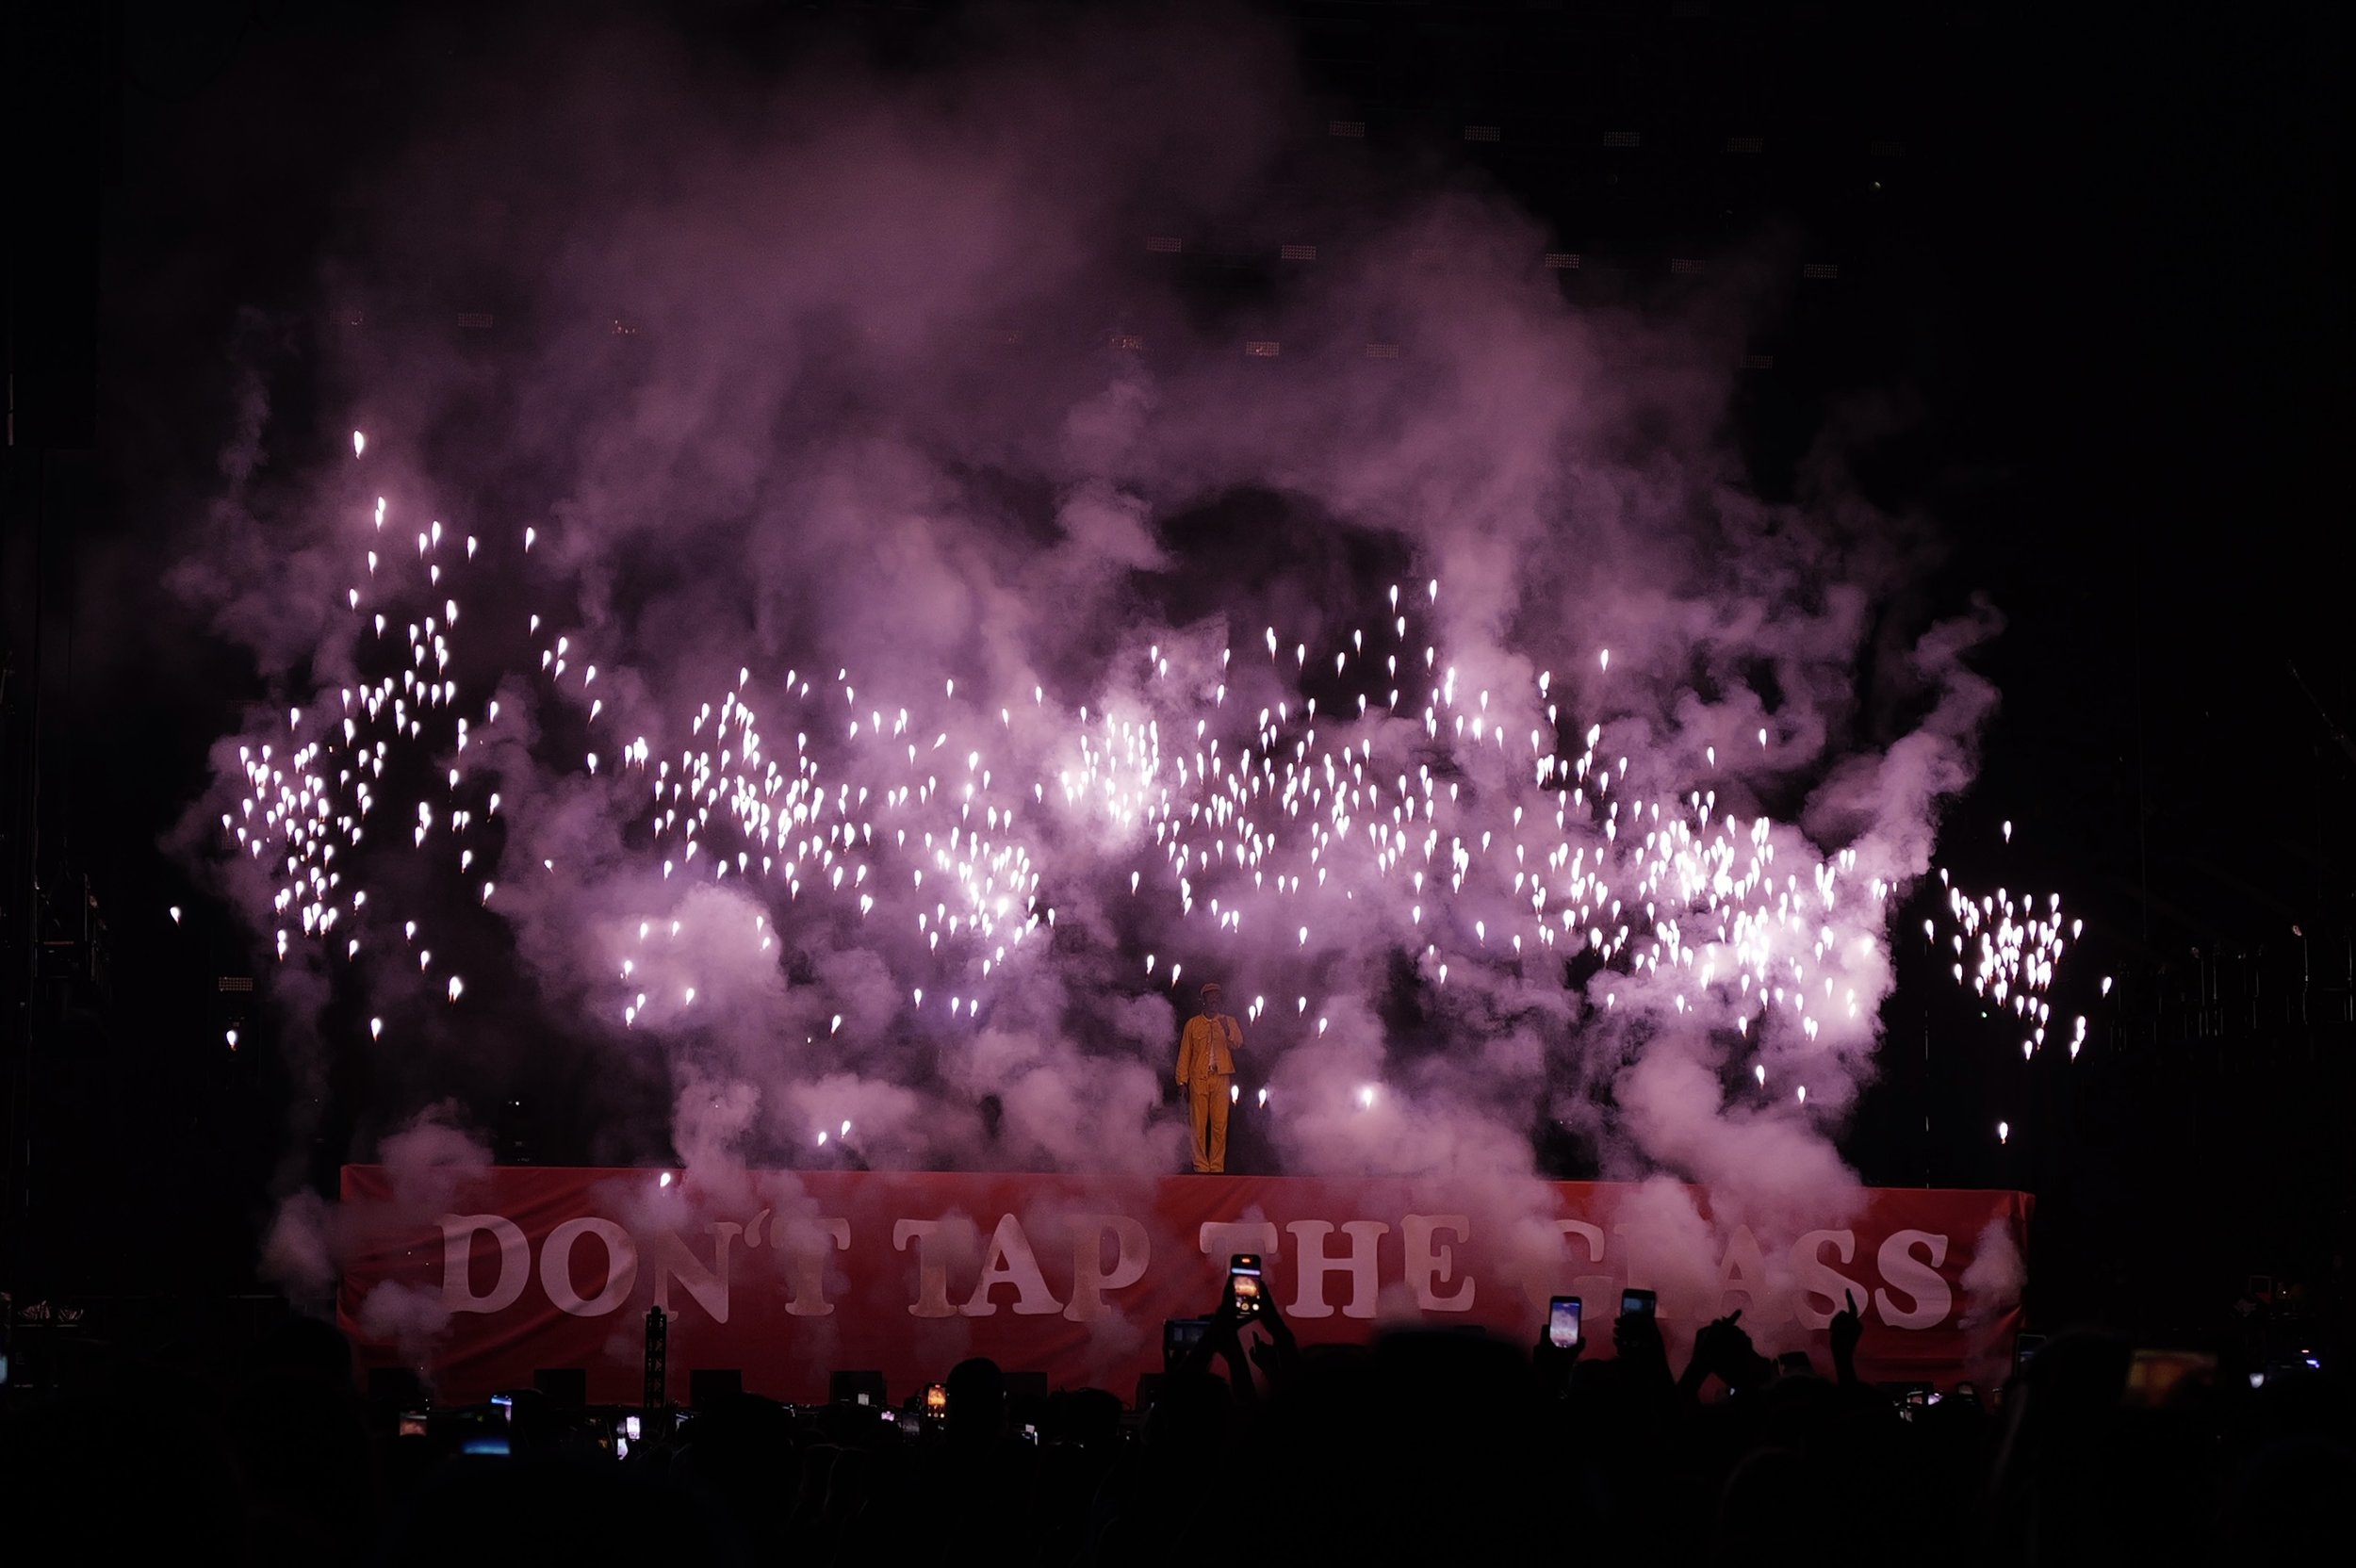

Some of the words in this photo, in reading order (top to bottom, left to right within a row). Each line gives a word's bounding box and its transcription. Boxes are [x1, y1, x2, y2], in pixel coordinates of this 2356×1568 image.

[435, 1209, 851, 1324] DON'T
[893, 1213, 1151, 1321] TAP
[1200, 1214, 1476, 1318] THE
